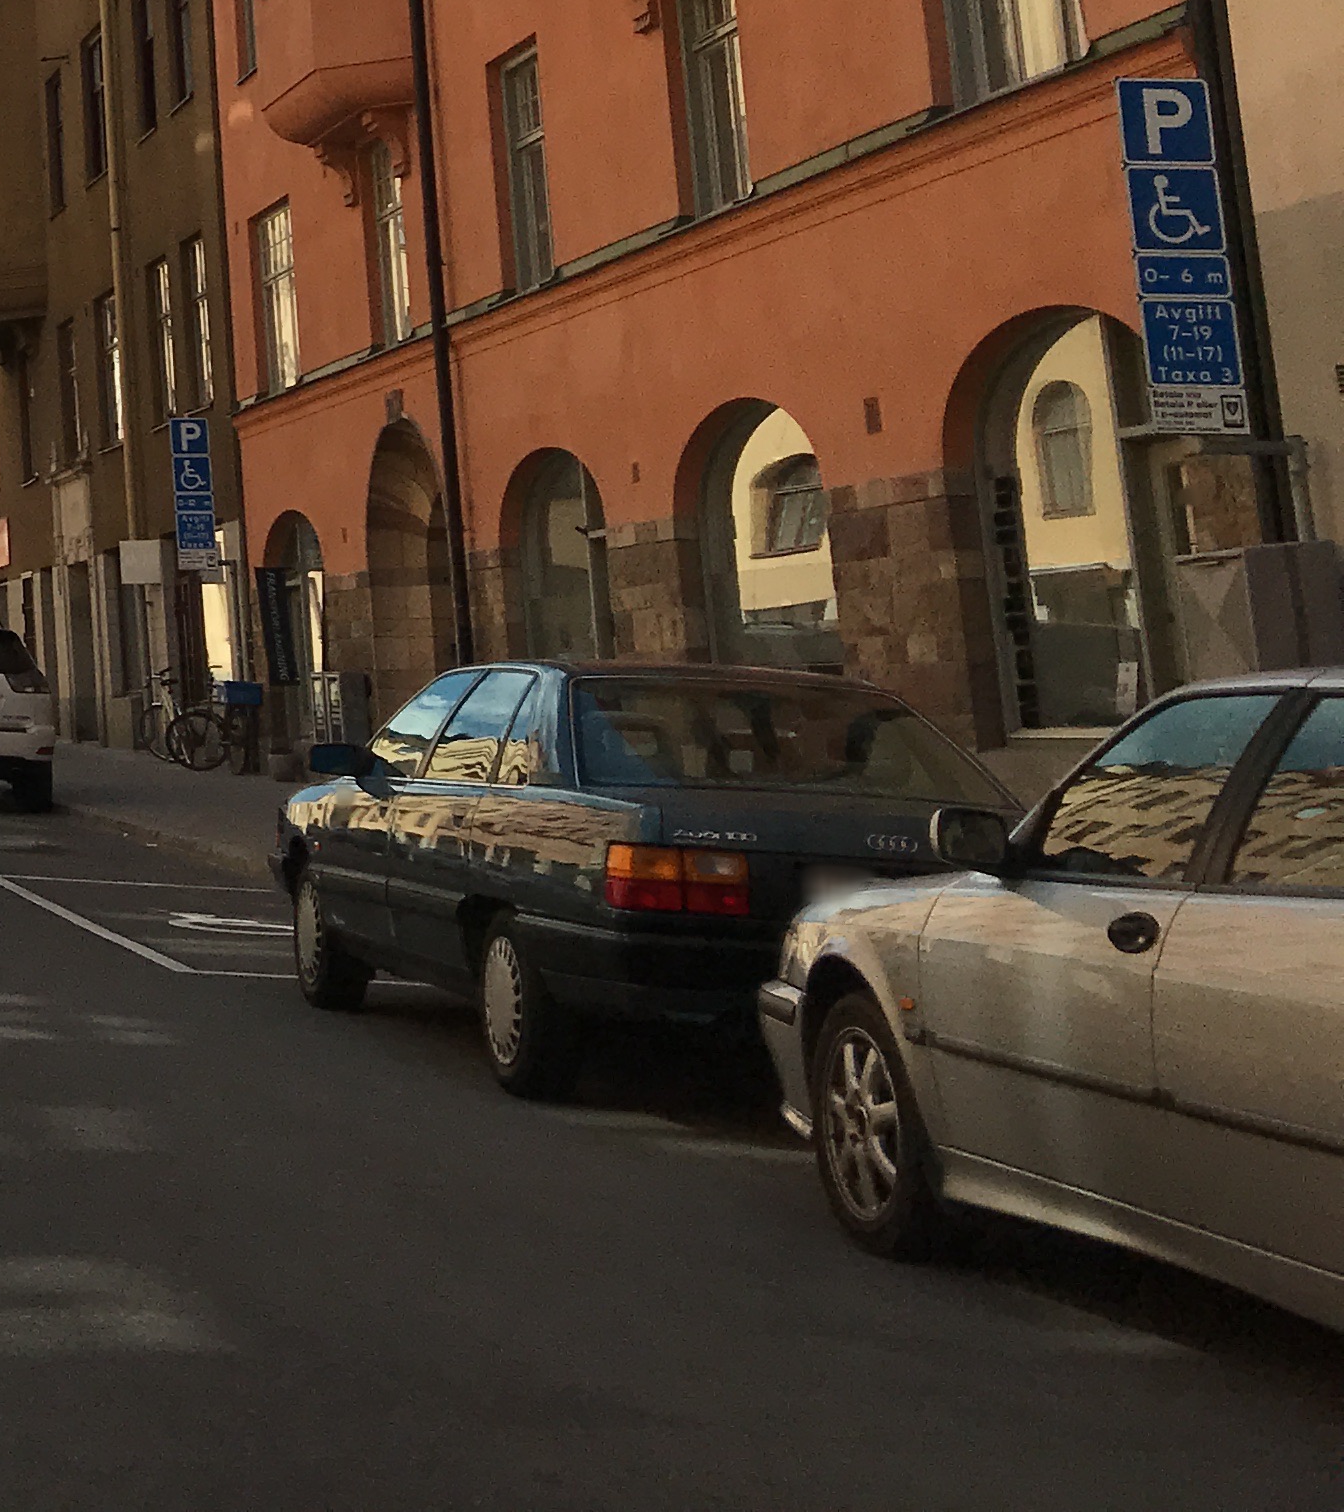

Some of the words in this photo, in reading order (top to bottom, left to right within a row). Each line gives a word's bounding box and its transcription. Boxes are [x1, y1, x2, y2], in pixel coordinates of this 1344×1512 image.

[1142, 88, 1193, 155] P
[1181, 268, 1194, 283] 6
[1207, 271, 1224, 284] m
[1155, 303, 1222, 323] Avgift
[1168, 325, 1212, 341] 7-19
[1163, 344, 1223, 363] (11-17)
[1157, 367, 1211, 383] Taxa
[1220, 368, 1233, 382] 3
[180, 422, 201, 452] P
